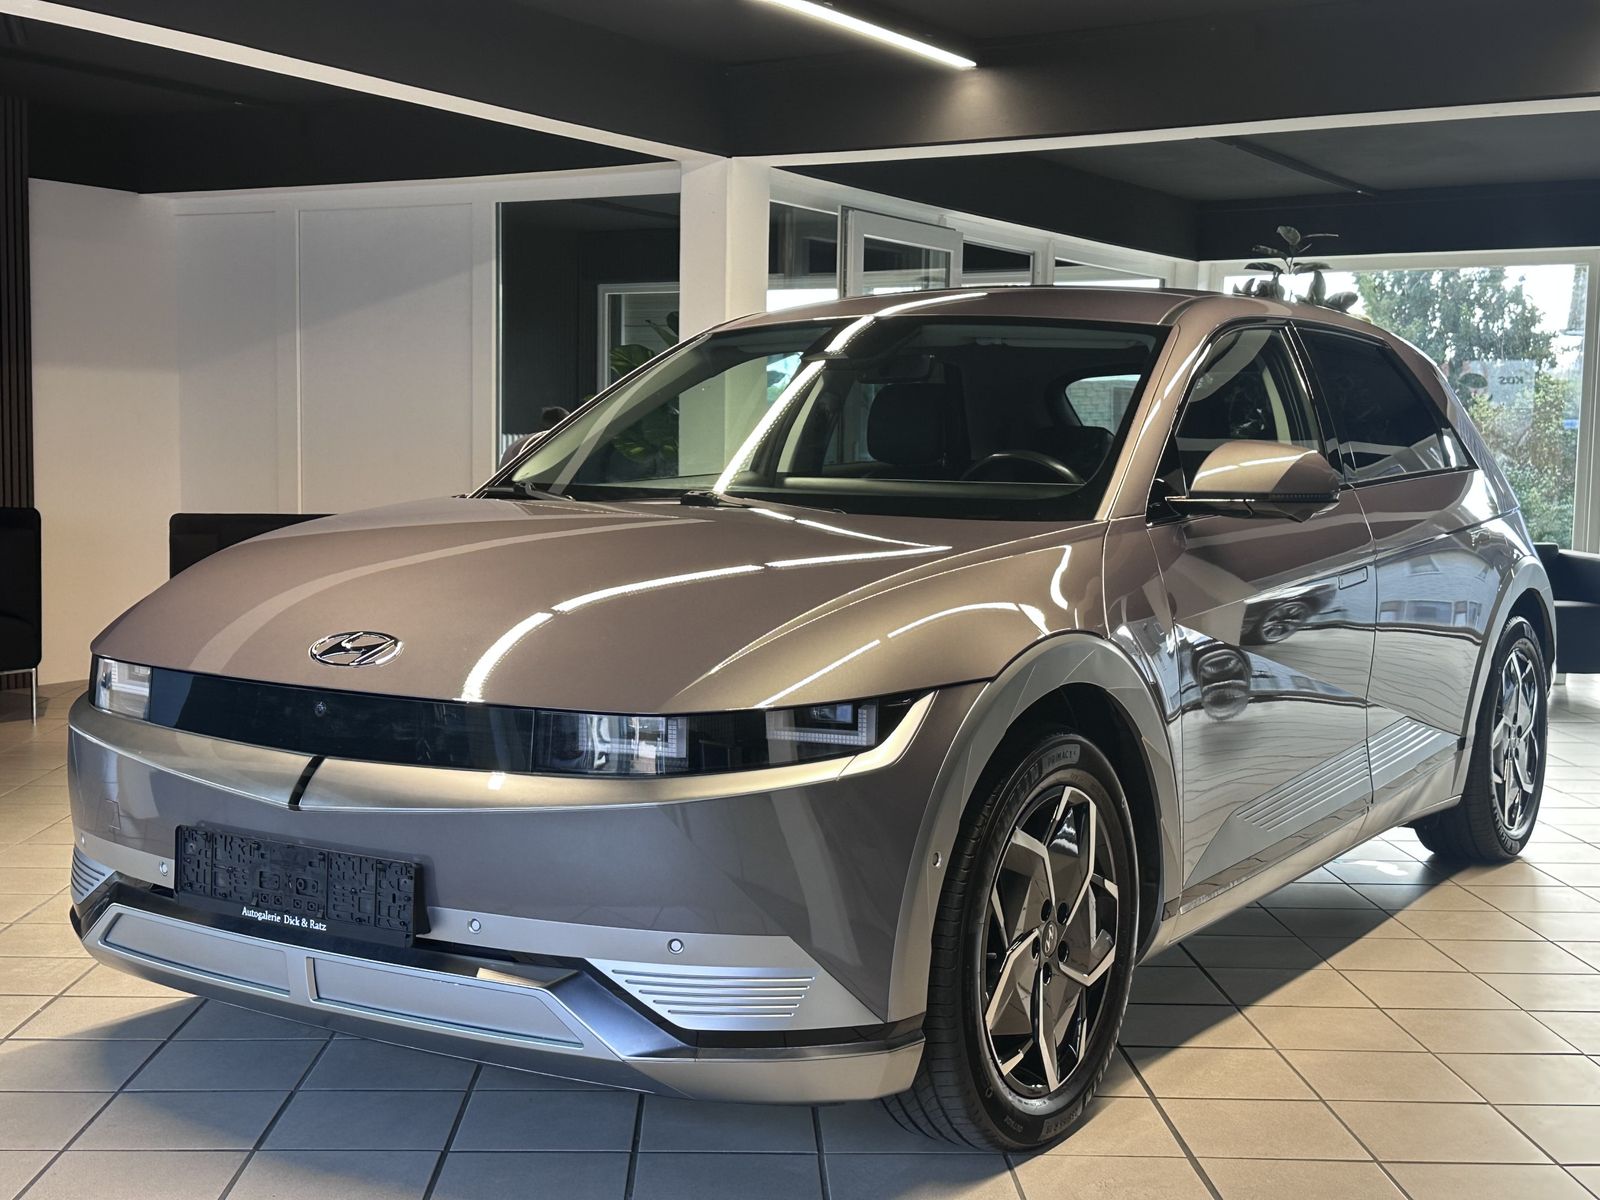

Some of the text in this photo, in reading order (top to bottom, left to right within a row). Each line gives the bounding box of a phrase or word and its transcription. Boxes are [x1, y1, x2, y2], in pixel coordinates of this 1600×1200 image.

[242, 906, 327, 931] Autogalerie Dick & Ratz
